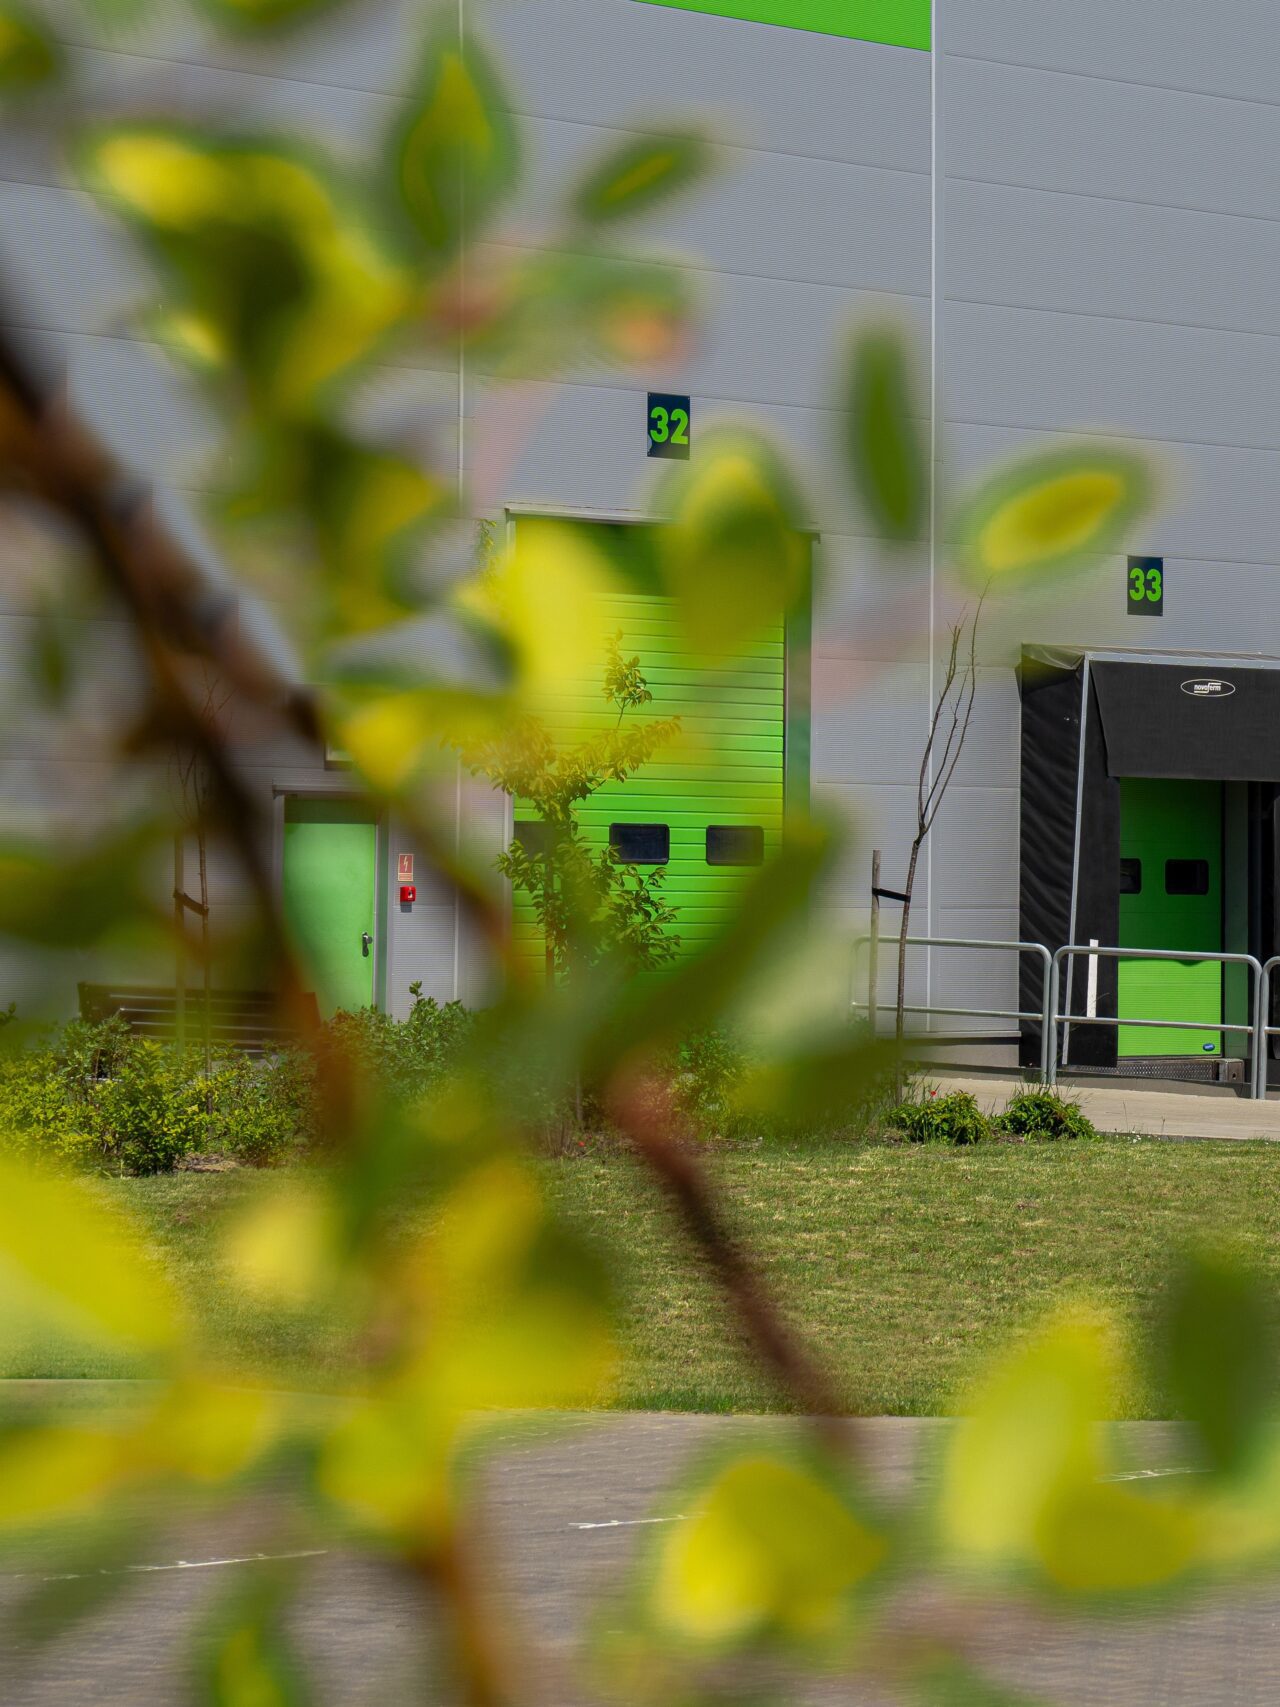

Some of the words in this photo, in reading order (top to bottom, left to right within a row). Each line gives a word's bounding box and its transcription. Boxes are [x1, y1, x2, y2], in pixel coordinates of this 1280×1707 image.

[650, 406, 688, 445] 32
[1129, 567, 1161, 602] 33
[1193, 682, 1221, 694] novoferm
